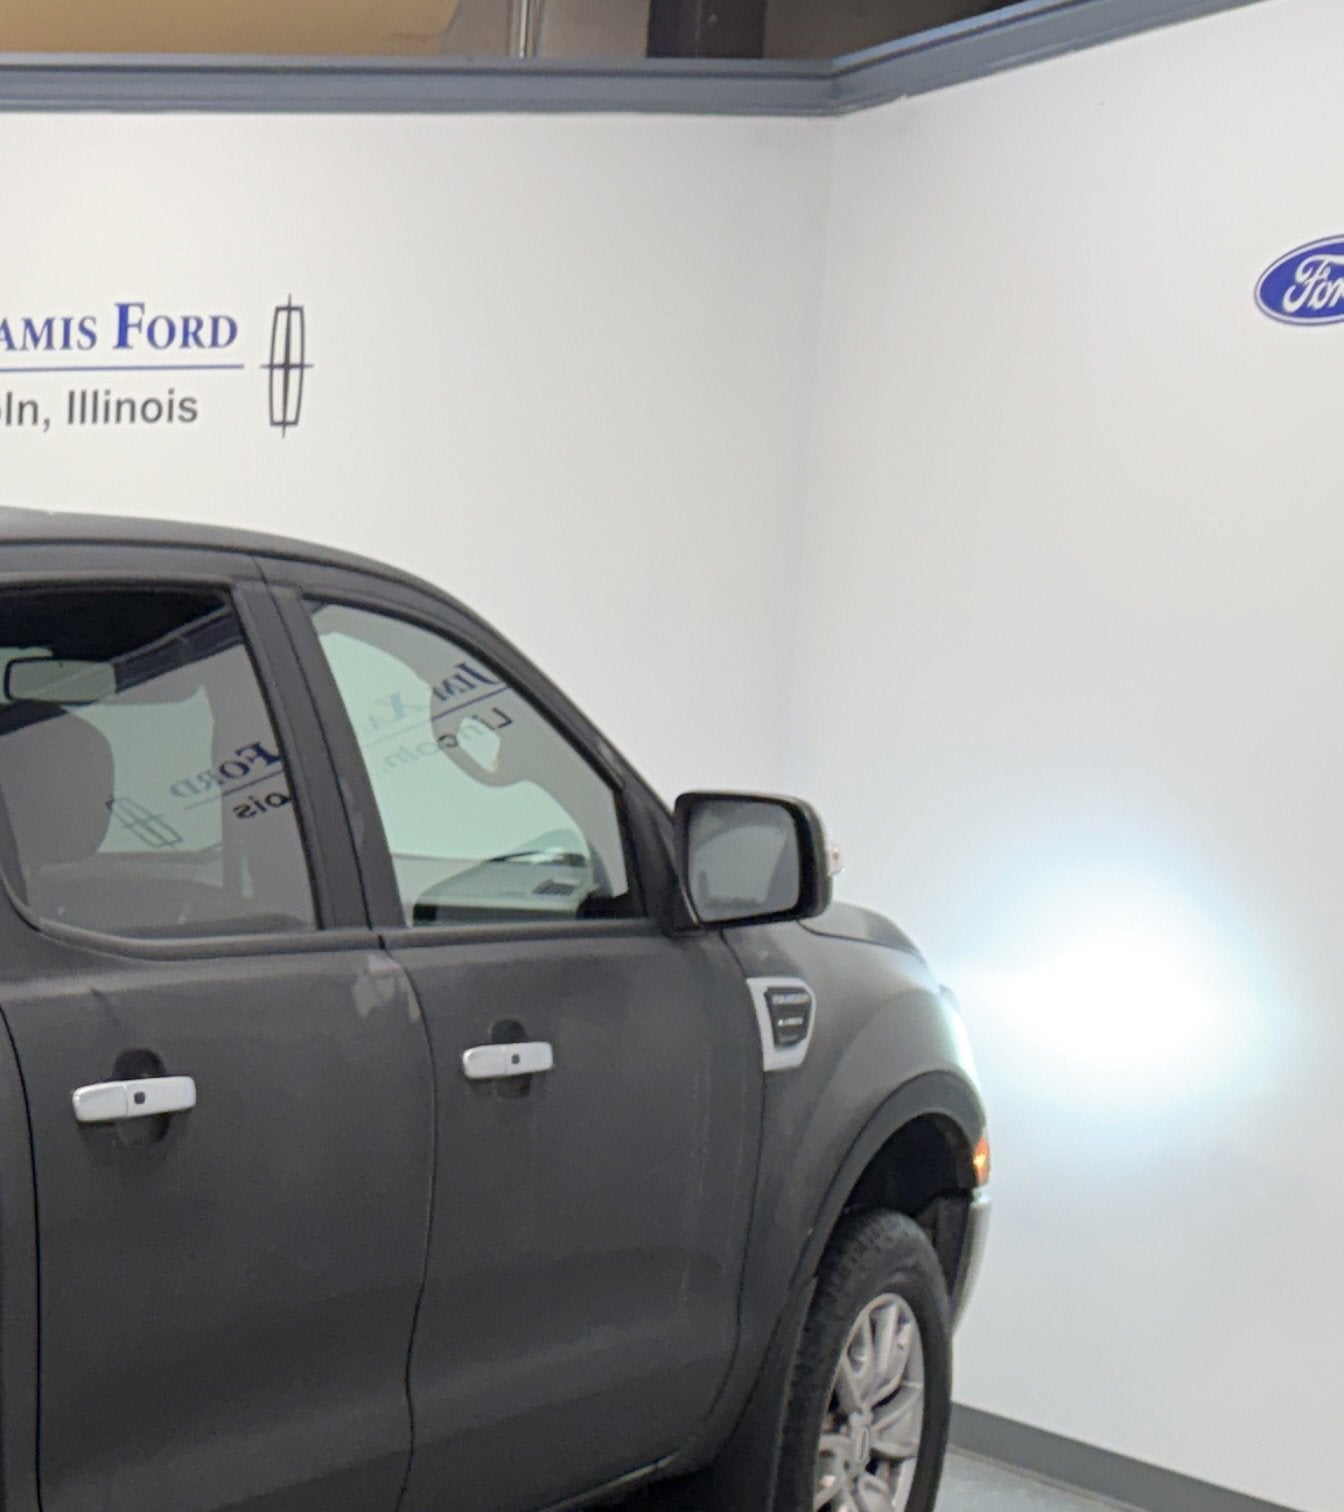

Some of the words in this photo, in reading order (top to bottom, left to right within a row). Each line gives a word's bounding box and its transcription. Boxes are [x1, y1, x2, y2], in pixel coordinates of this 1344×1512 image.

[1283, 253, 1344, 313] For
[112, 301, 239, 350] FORD
[67, 387, 199, 426] Illinois
